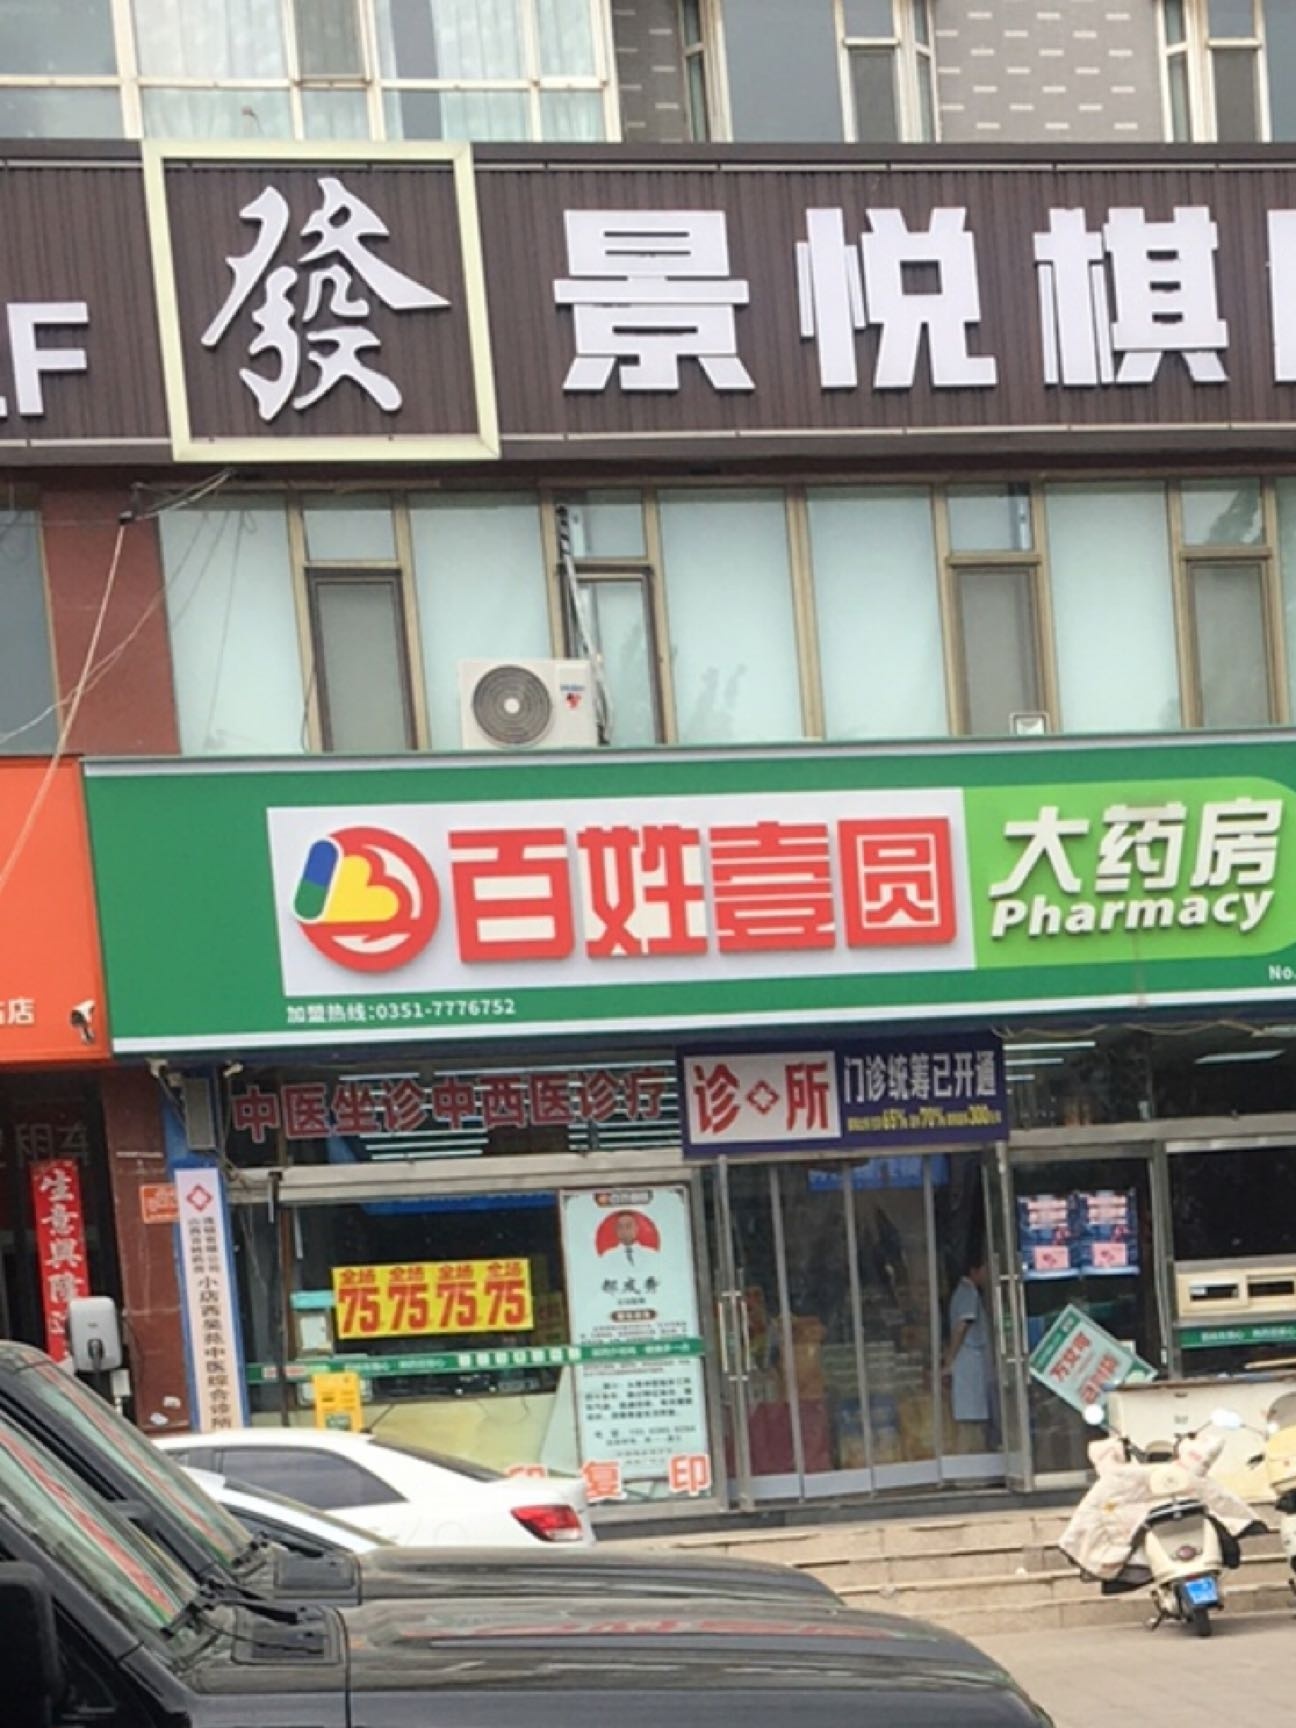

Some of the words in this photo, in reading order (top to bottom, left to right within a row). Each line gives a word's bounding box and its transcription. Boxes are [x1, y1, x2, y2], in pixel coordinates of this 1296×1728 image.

[200, 176, 451, 421] 發
[0, 302, 88, 416] F
[447, 815, 958, 965] 百姓壹圆
[988, 798, 1284, 899] 大药房
[990, 889, 1274, 939] Pharmacy
